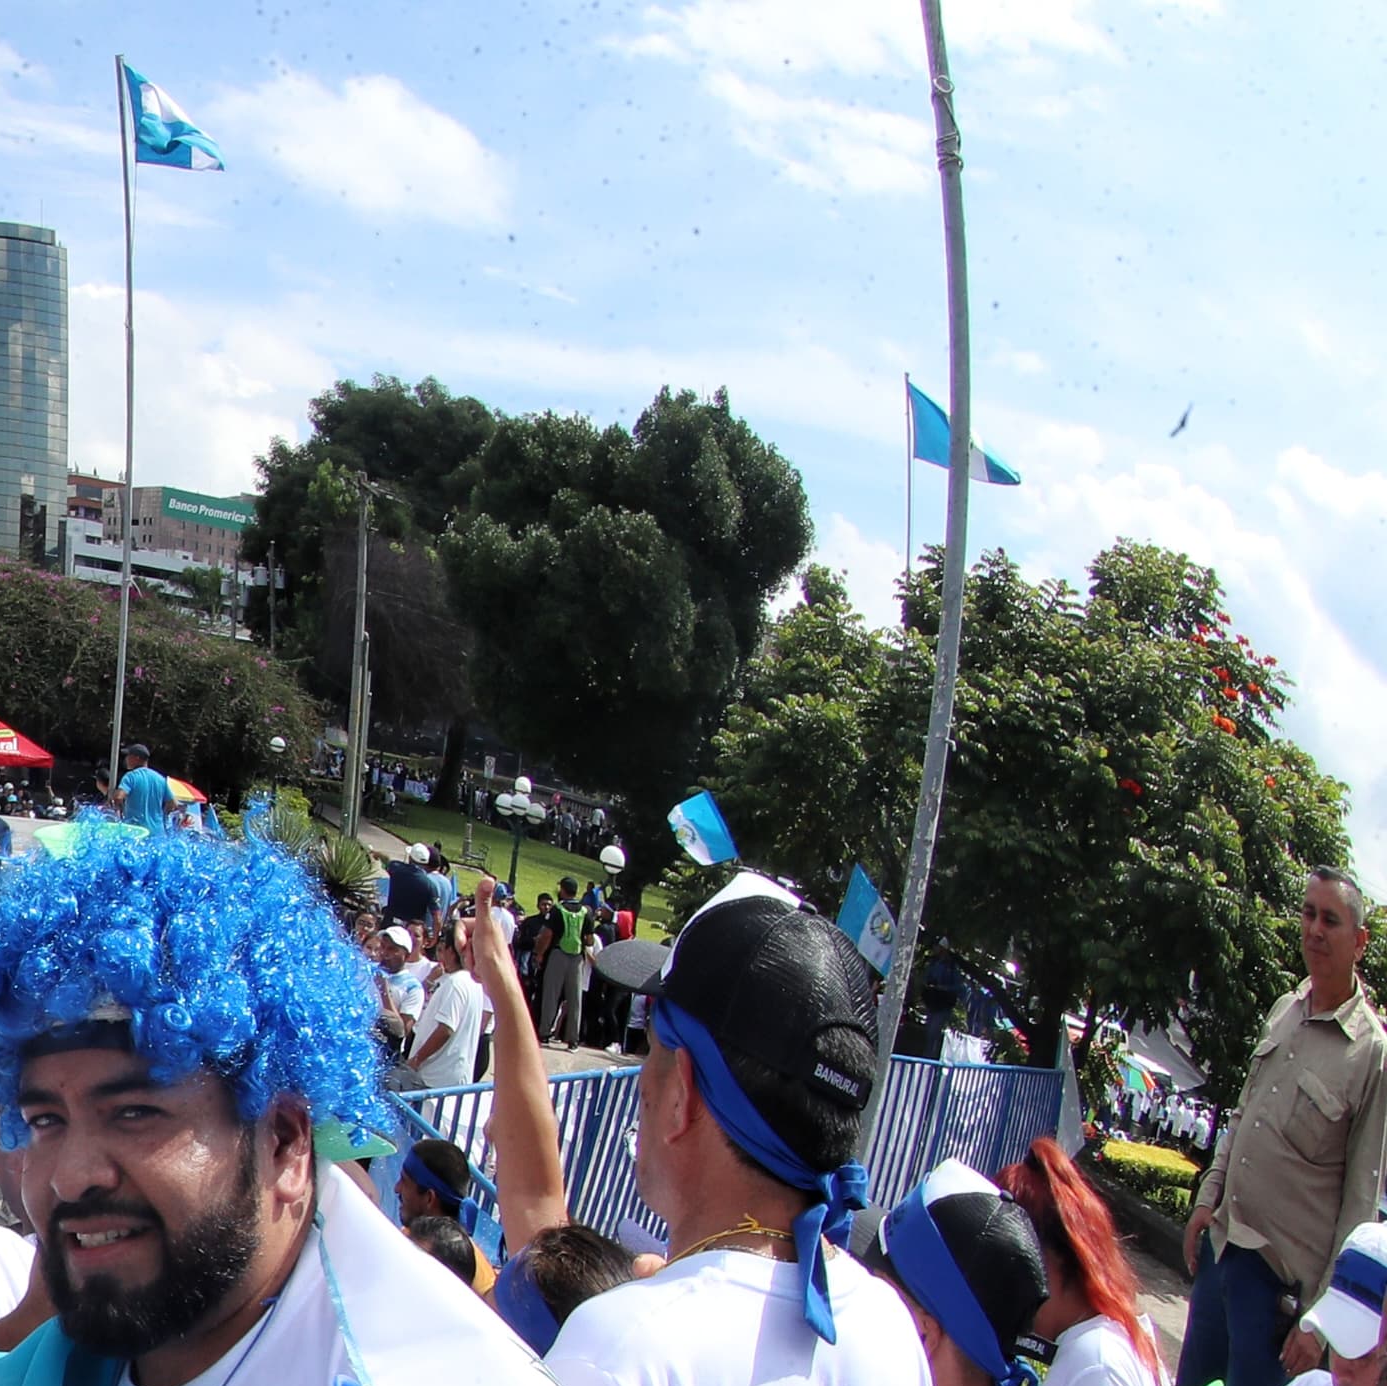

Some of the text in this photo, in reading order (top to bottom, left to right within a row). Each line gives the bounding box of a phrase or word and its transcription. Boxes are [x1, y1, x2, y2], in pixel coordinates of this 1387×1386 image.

[168, 498, 246, 523] Banco Promerica
[814, 1063, 859, 1097] BANRURAL
